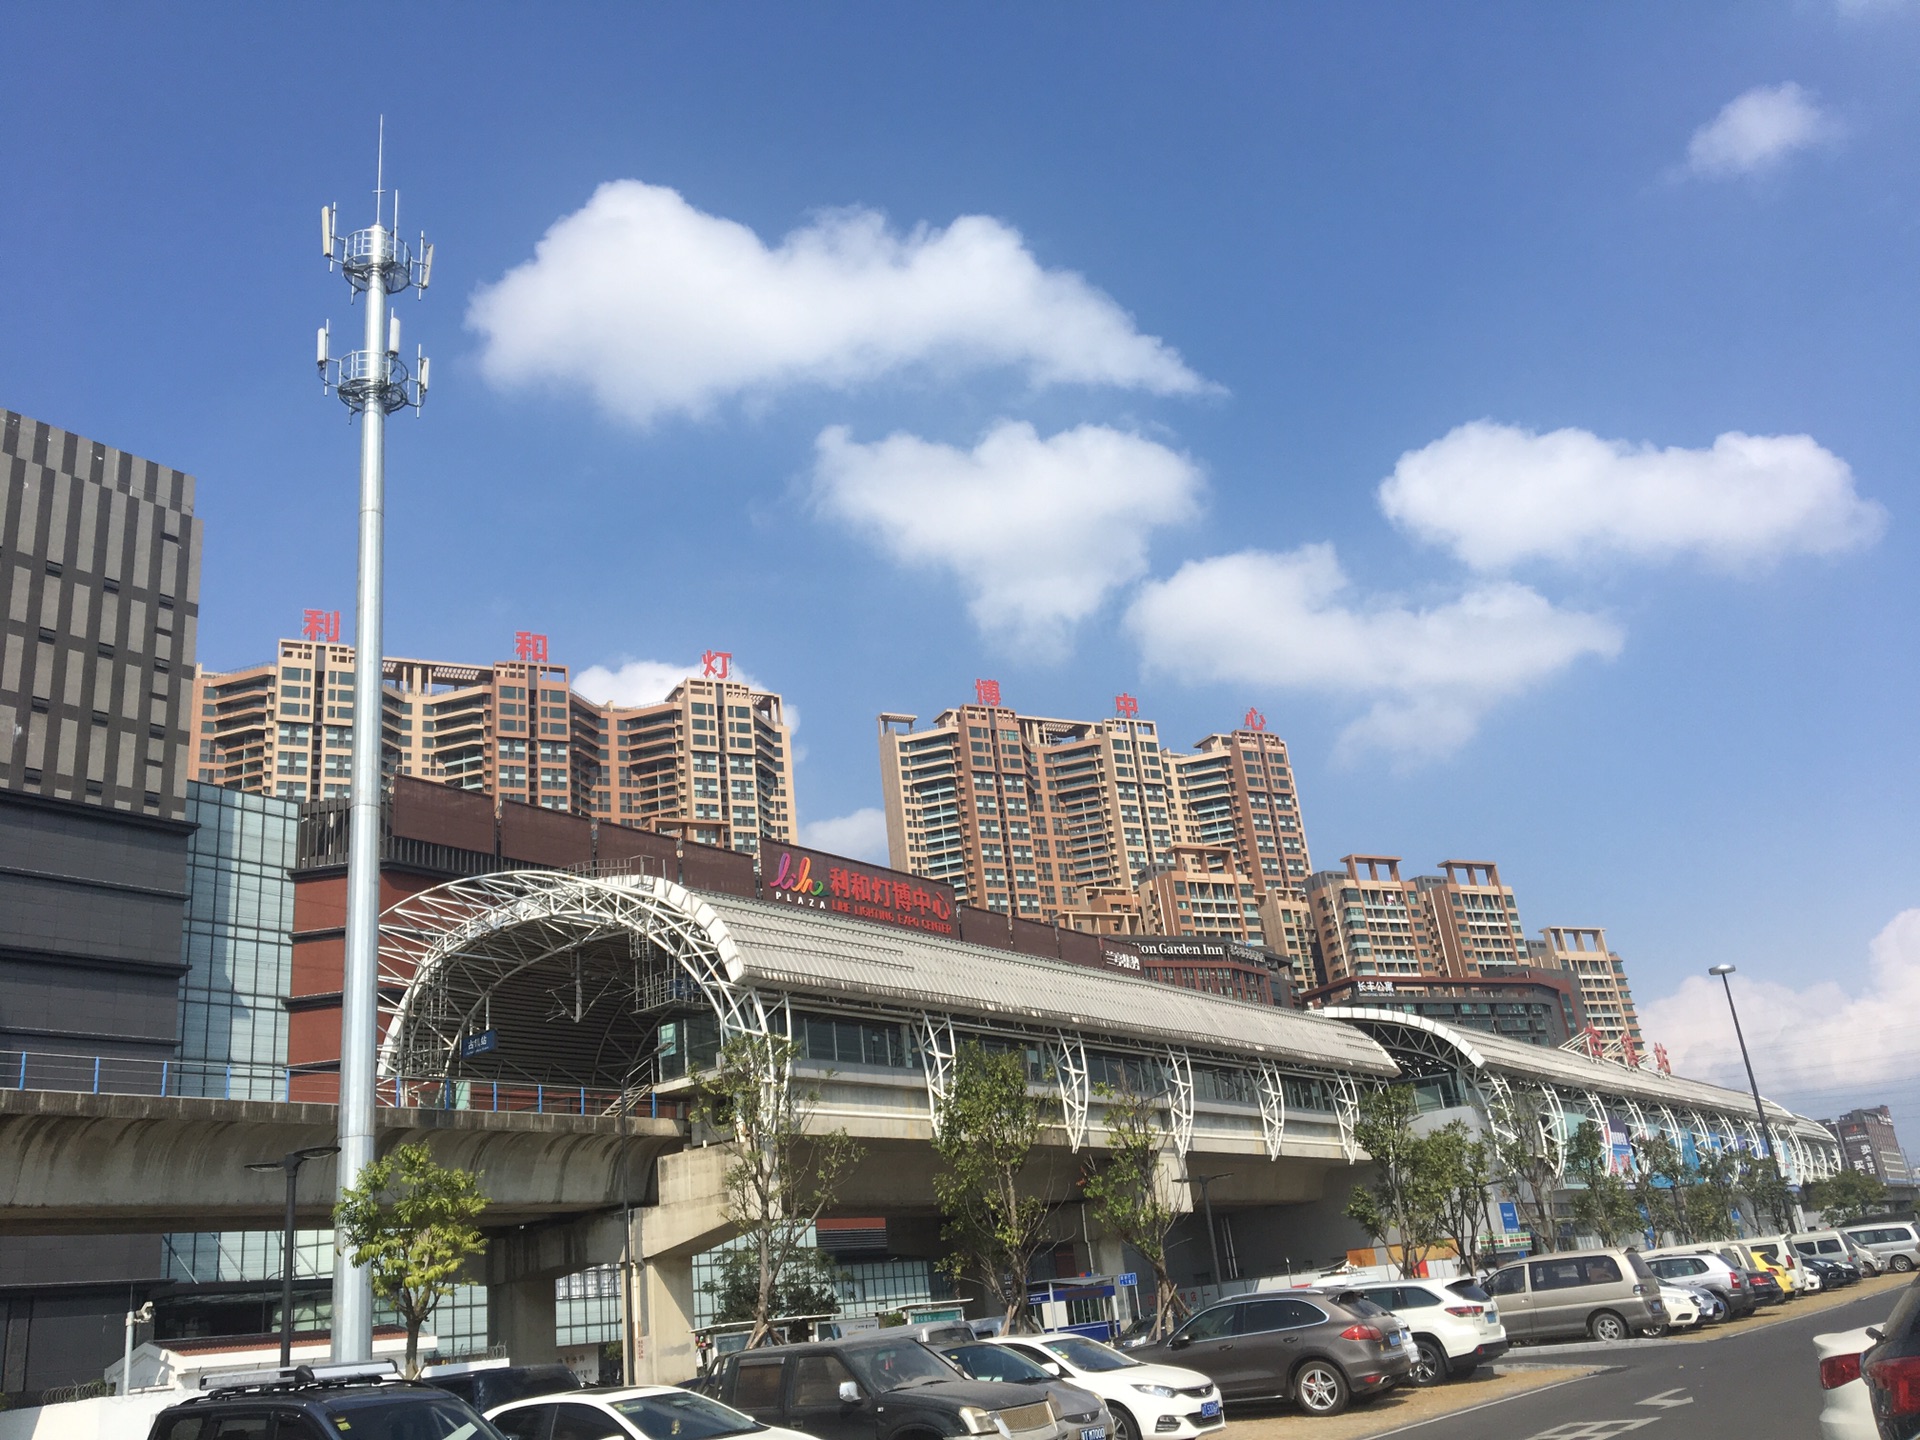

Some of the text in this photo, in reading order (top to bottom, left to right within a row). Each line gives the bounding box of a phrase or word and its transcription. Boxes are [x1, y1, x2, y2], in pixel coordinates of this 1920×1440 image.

[303, 609, 1266, 731] 利 和 灯 博 中 心
[775, 891, 826, 909] PLAZA
[829, 867, 951, 920] 利和灯博中心
[854, 905, 894, 922] LIGHTING
[897, 913, 919, 927] EXPO
[921, 919, 952, 933] CENTER
[1158, 942, 1201, 954] Garden
[1202, 943, 1223, 955] Inn
